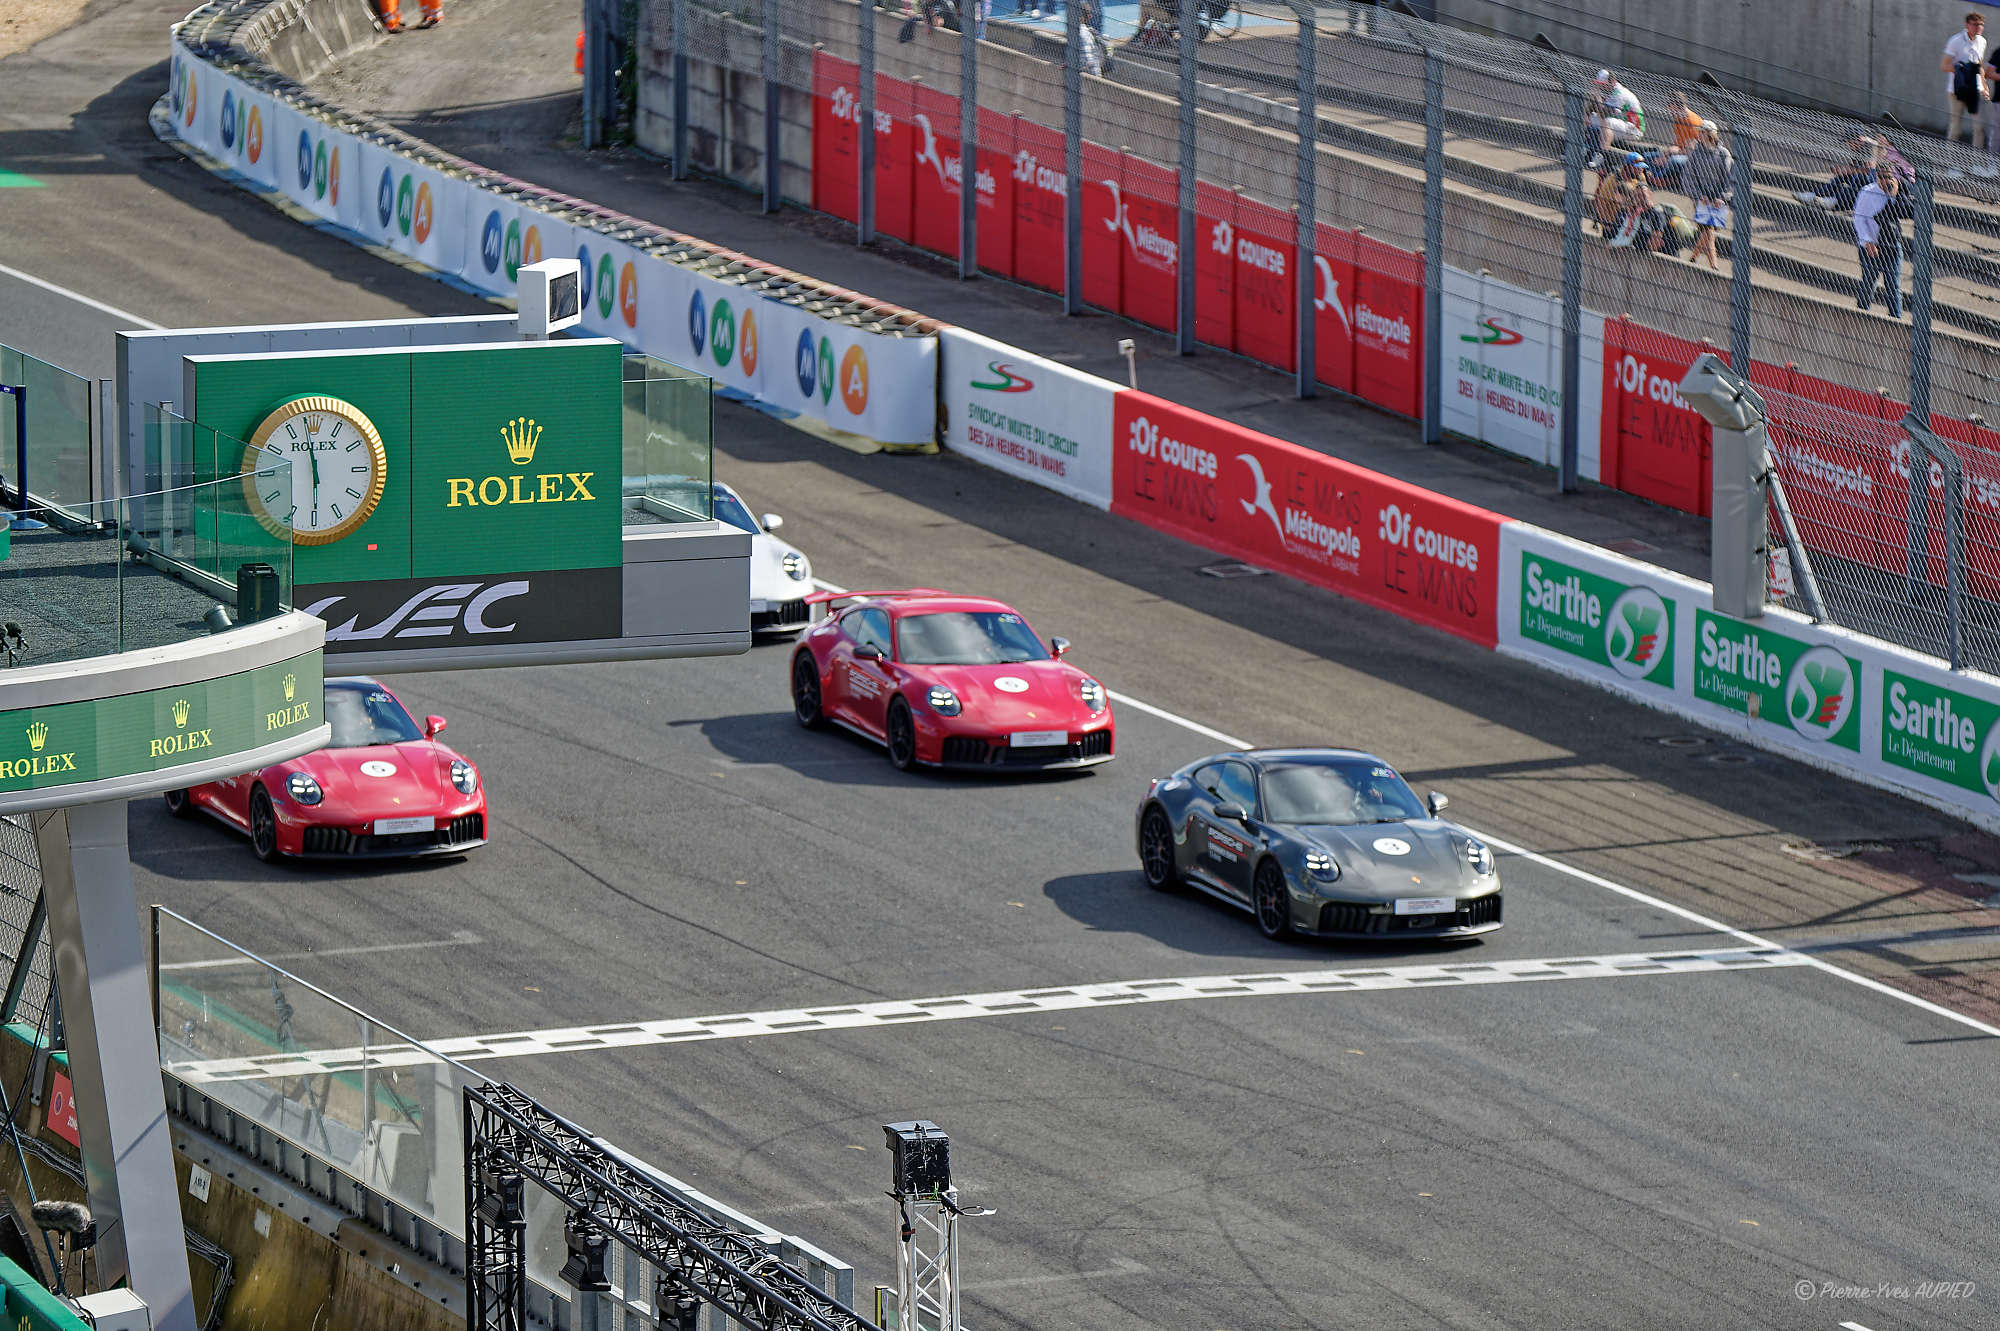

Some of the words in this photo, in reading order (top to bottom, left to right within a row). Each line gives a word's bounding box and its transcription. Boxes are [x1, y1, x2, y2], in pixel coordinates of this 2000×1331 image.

[291, 440, 337, 452] ROLEX
[1160, 436, 1218, 479] course
[446, 471, 596, 508] ROLEX
[1285, 507, 1361, 558] Métropole
[1413, 525, 1479, 572] course
[1526, 561, 1602, 629] Sarthe
[1525, 610, 1537, 628] Le
[1537, 613, 1584, 647] Département
[1700, 619, 1782, 689] Sarthe
[1700, 669, 1711, 689] Le
[266, 701, 311, 732] ROLEX
[1889, 681, 1976, 754] Sarthe
[149, 728, 213, 758] ROLEX
[1888, 732, 1900, 754] Le
[1902, 737, 1956, 775] Département
[0, 752, 77, 780] ROLEX
